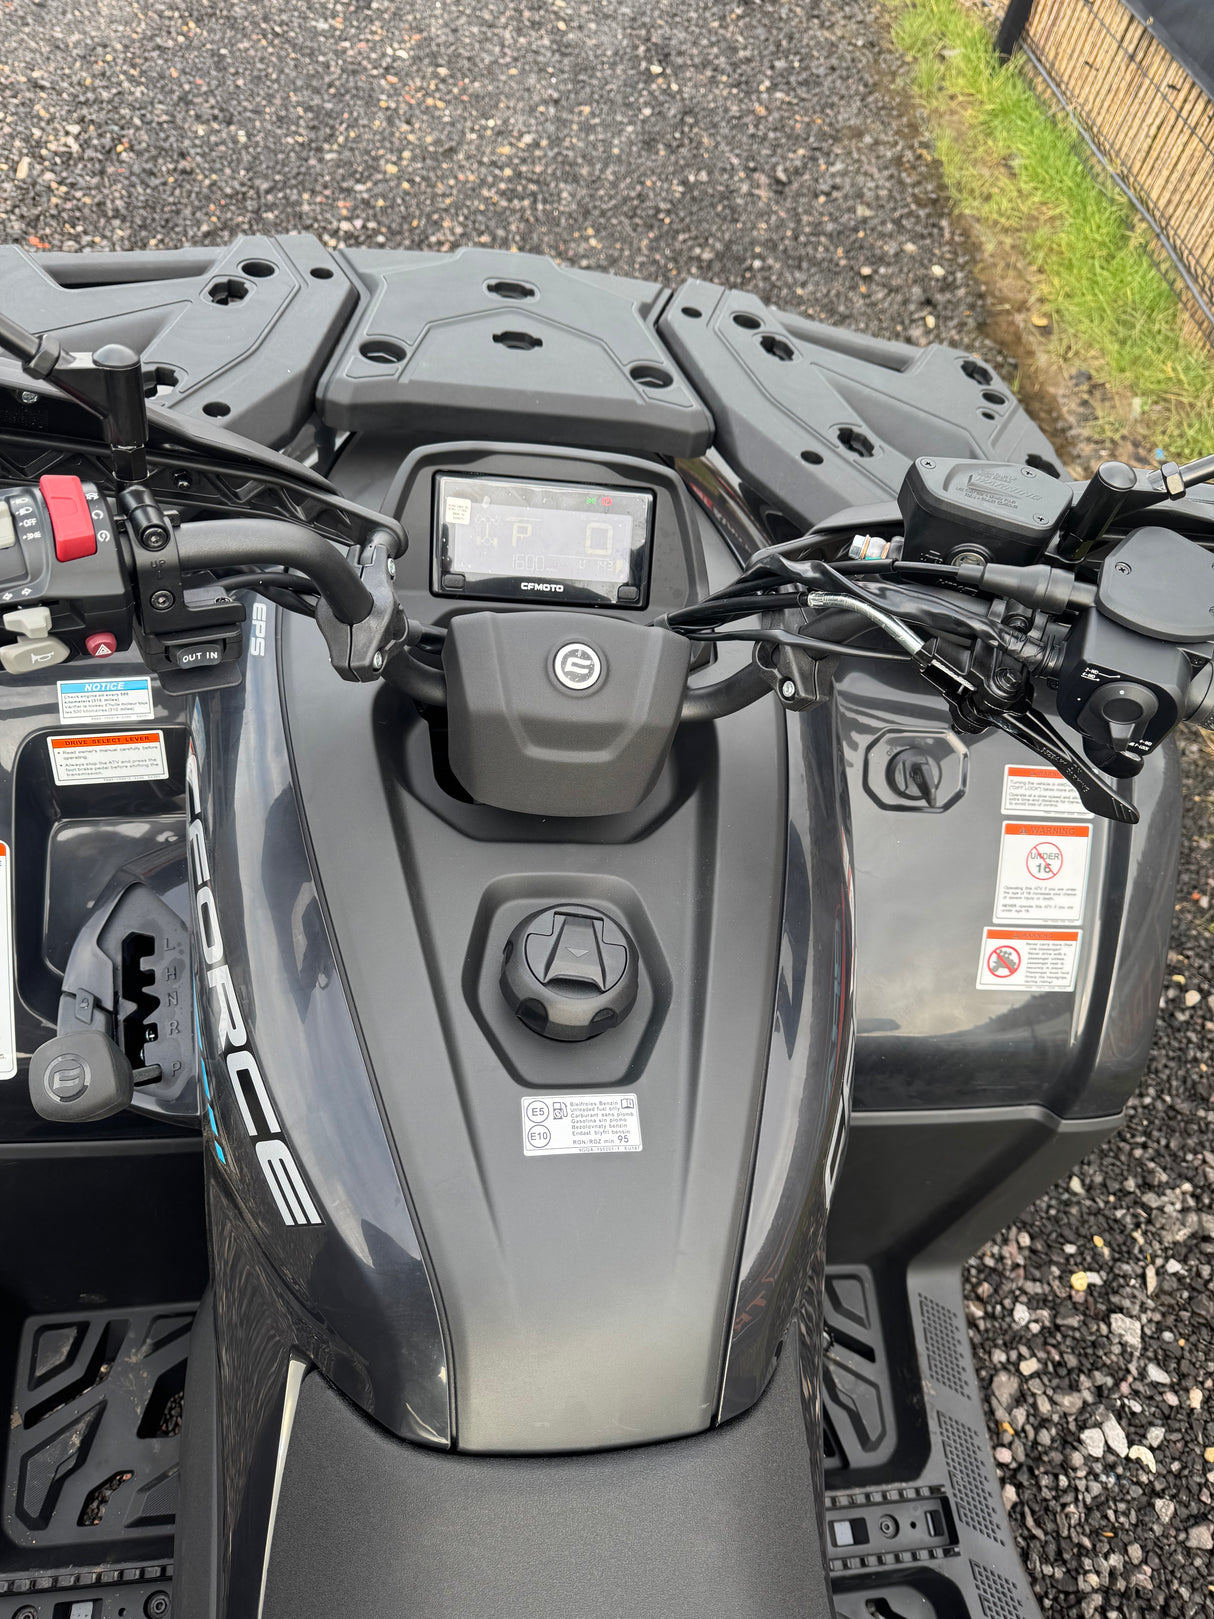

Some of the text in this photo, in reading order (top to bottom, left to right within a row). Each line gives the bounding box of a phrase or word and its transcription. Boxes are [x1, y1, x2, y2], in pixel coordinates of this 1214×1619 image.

[512, 523, 532, 547] P
[512, 554, 544, 571] 1600
[521, 582, 564, 592] CFMOTO
[251, 603, 266, 656] EPS
[183, 653, 202, 662] OUT
[85, 682, 125, 691] NOTICE
[1031, 827, 1076, 835] WARNING
[1030, 852, 1060, 860] UNDER
[1036, 863, 1052, 873] 16
[165, 938, 176, 951] L
[166, 966, 176, 981] H
[187, 754, 322, 1226] CFORCE
[168, 991, 178, 1007] N
[169, 1020, 180, 1035] R
[172, 1060, 181, 1077] P
[532, 1107, 544, 1116] E5
[530, 1132, 548, 1140] E10
[617, 1135, 629, 1143] 95
